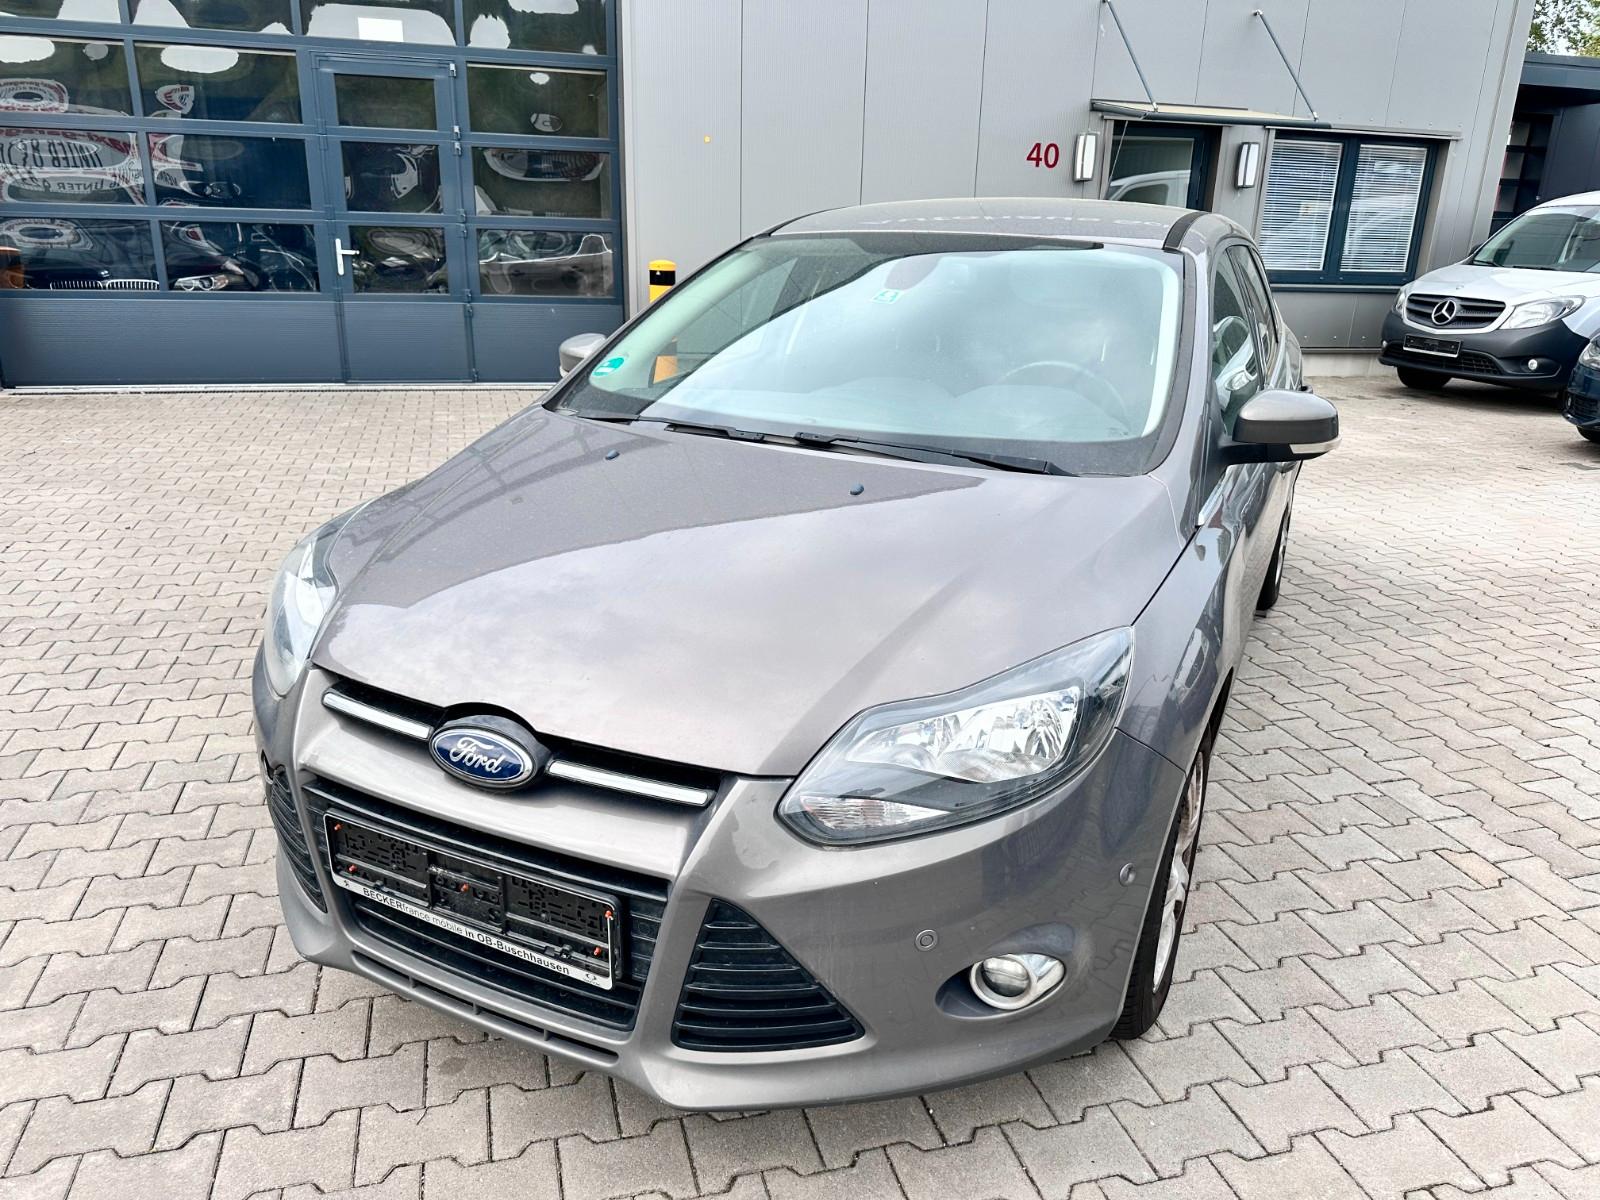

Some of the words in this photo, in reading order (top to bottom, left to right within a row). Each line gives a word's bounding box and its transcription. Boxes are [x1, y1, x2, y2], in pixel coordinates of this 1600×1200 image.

[1026, 143, 1059, 168] 40
[449, 736, 505, 773] Ford
[432, 917, 463, 934] mobile
[465, 930, 475, 939] in
[477, 933, 570, 975] OB-Buschhausen
